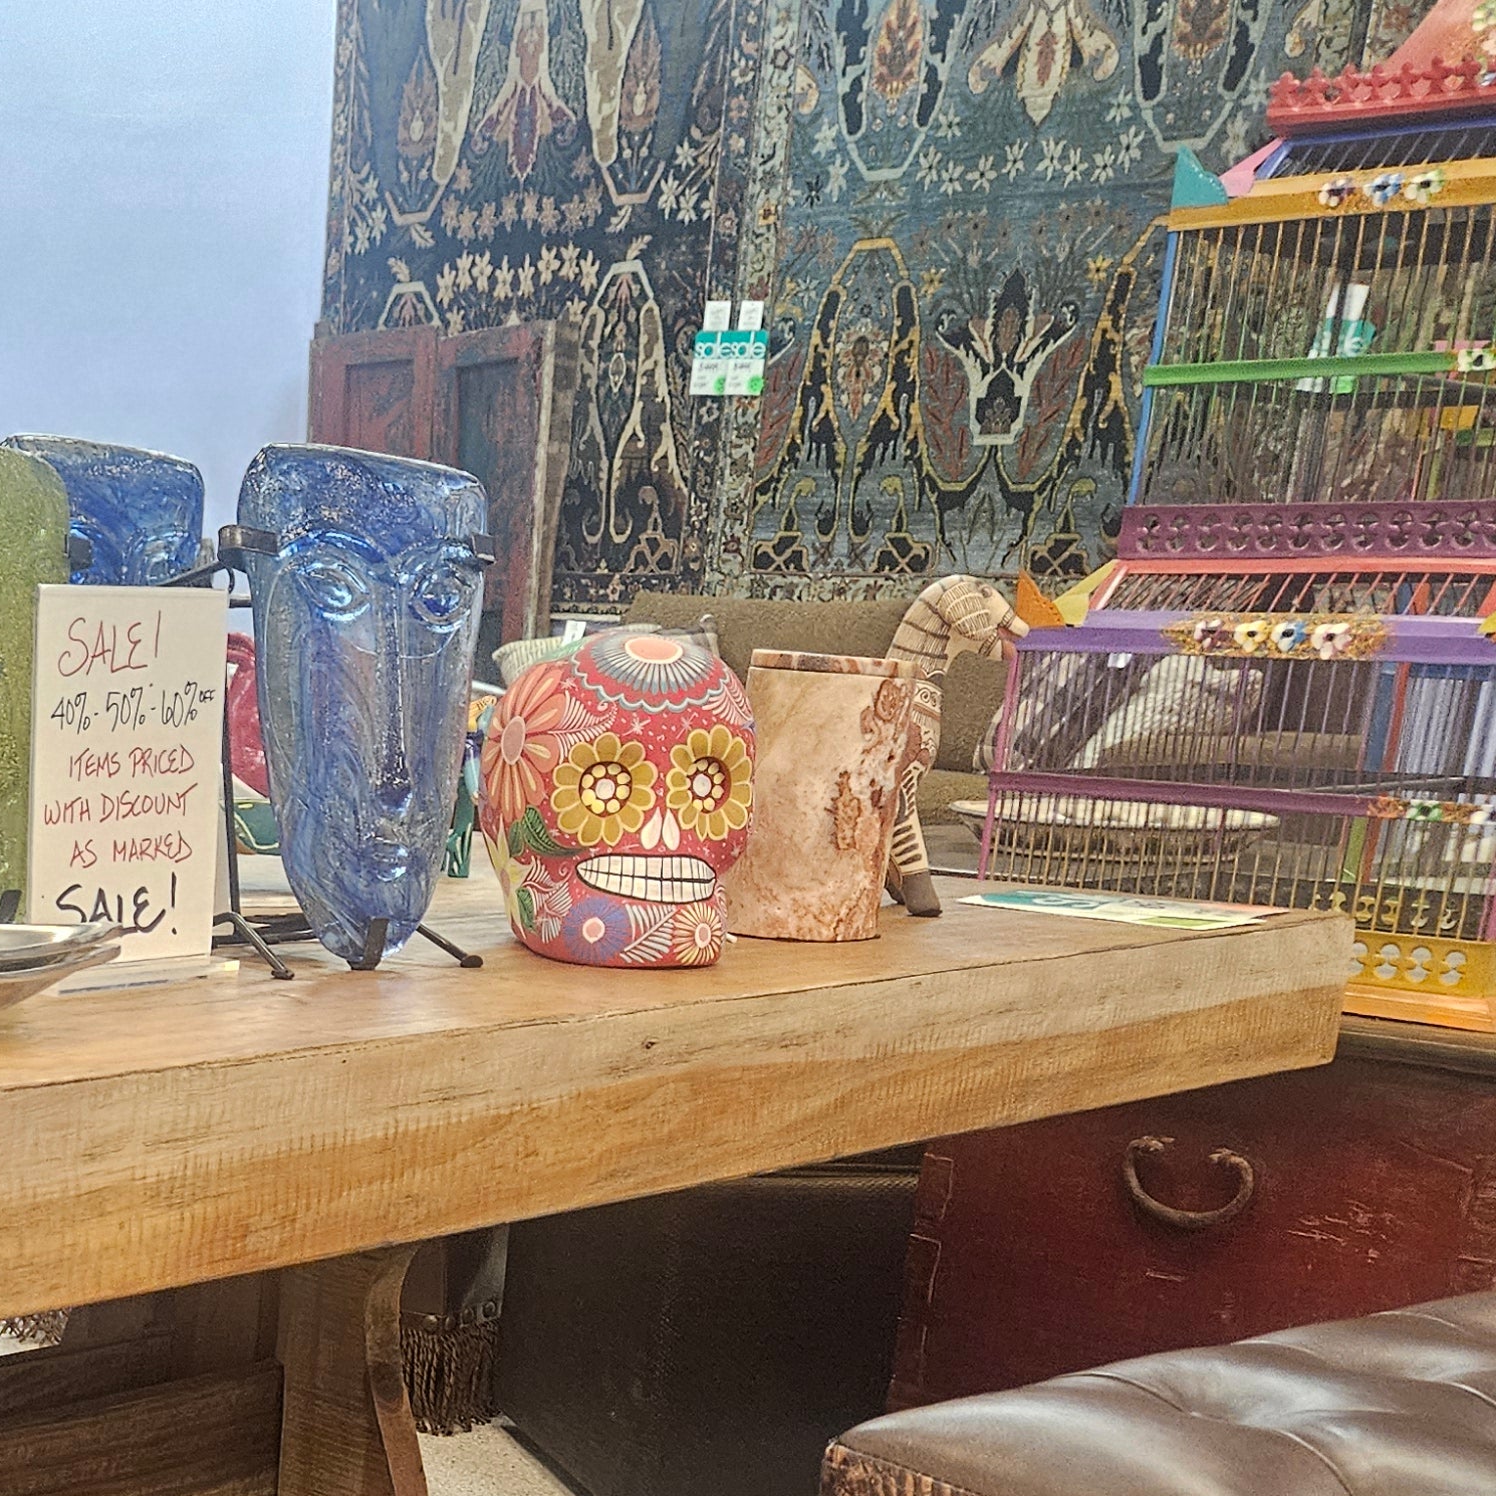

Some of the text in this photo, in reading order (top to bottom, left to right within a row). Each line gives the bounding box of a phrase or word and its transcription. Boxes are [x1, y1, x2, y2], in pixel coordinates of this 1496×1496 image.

[694, 330, 733, 359] sale
[731, 330, 767, 359] sale
[57, 610, 162, 687] SALE!
[68, 744, 195, 782] ITEMS PRICED
[44, 782, 199, 826] WITH DISCOUNT
[70, 830, 193, 869] AS MARKED
